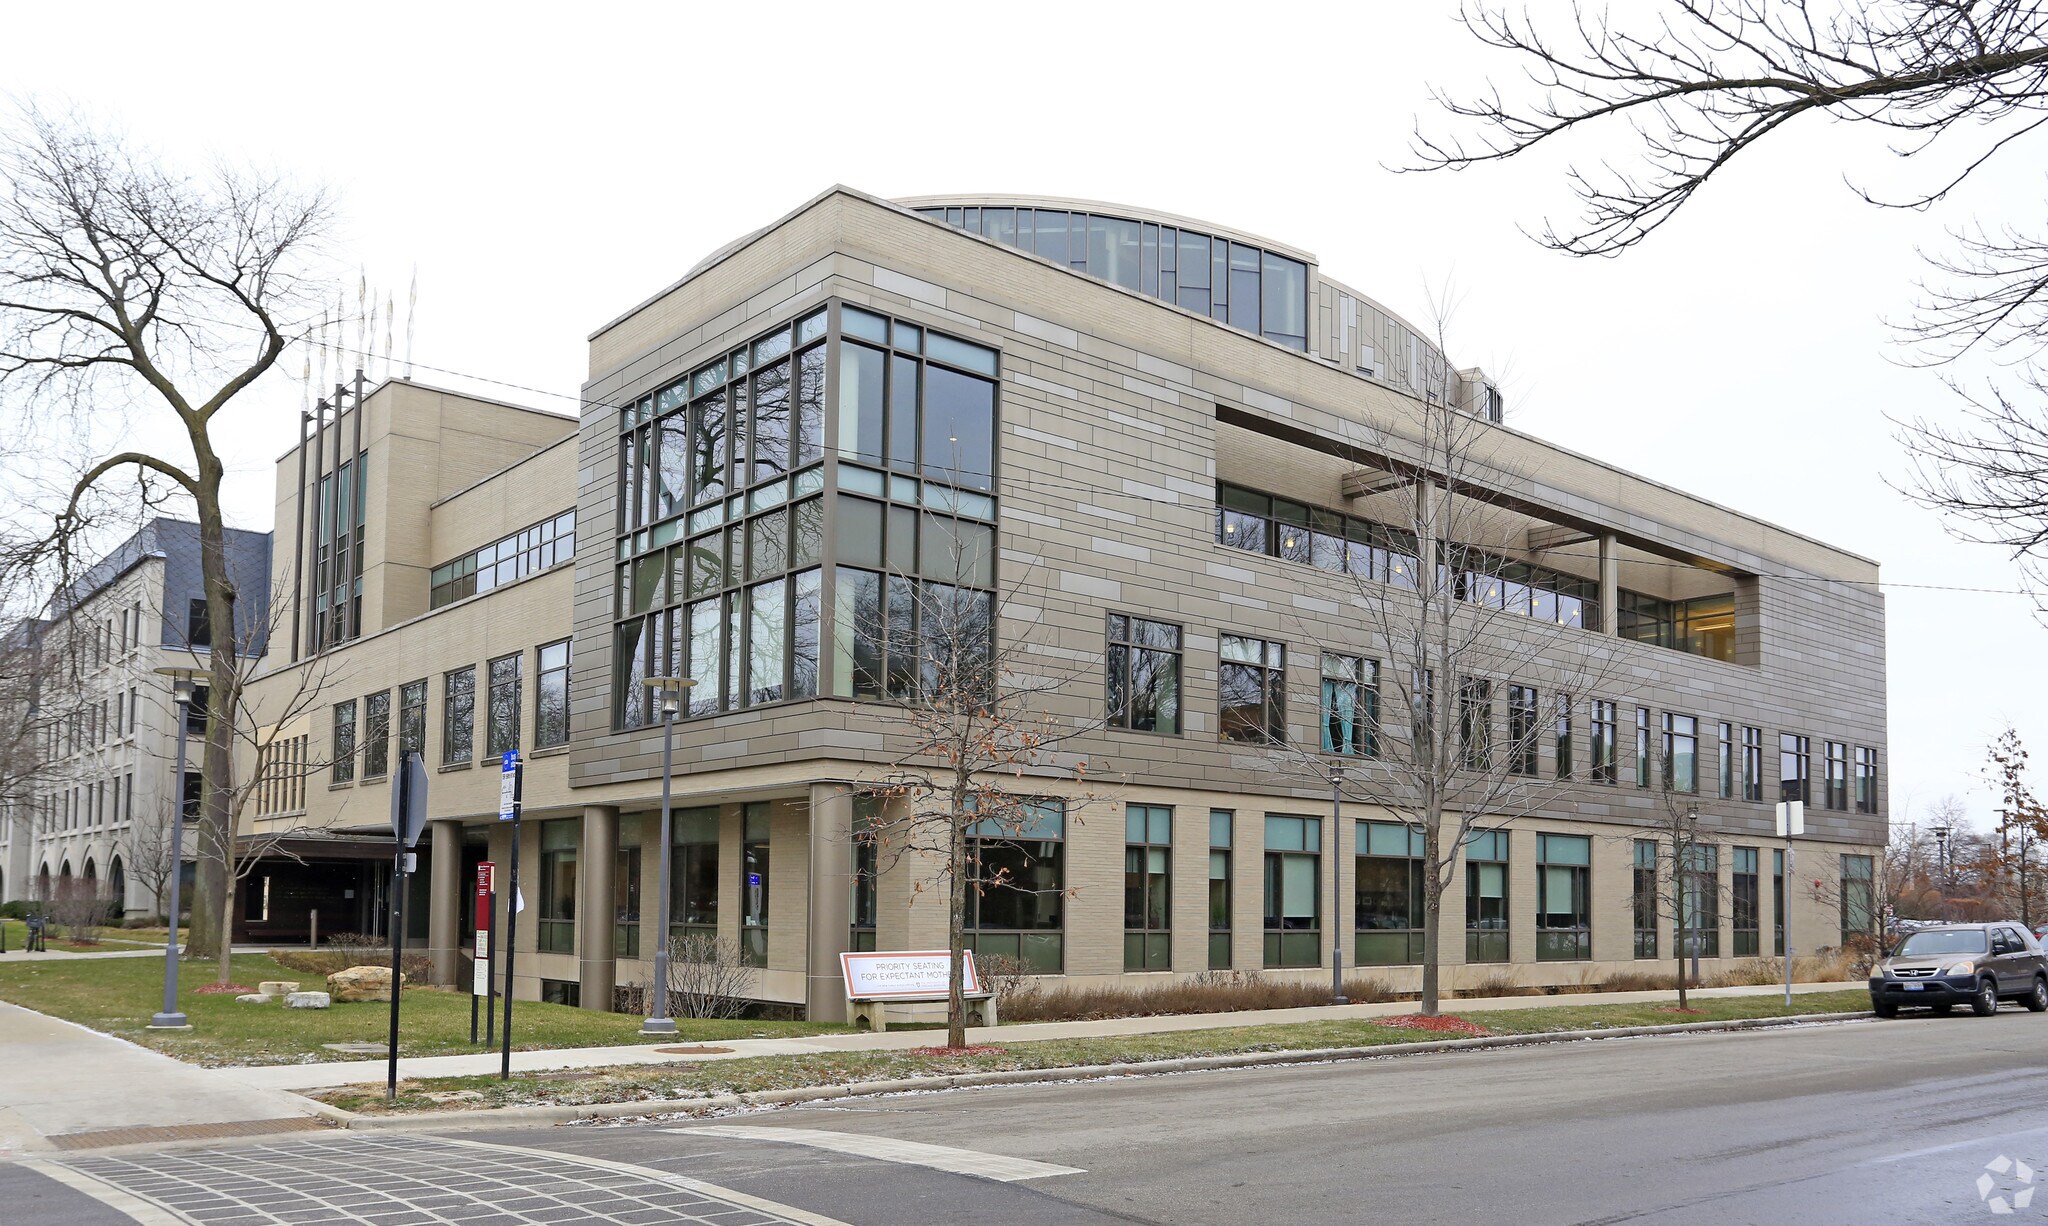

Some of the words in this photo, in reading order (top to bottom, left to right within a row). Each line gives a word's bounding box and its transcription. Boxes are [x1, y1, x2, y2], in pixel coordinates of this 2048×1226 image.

[876, 963, 911, 971] PRIORITY
[913, 962, 945, 970] SEATING
[861, 973, 878, 981] FOR
[880, 972, 924, 980] EXPECTANT
[926, 970, 951, 979] MOTHE
